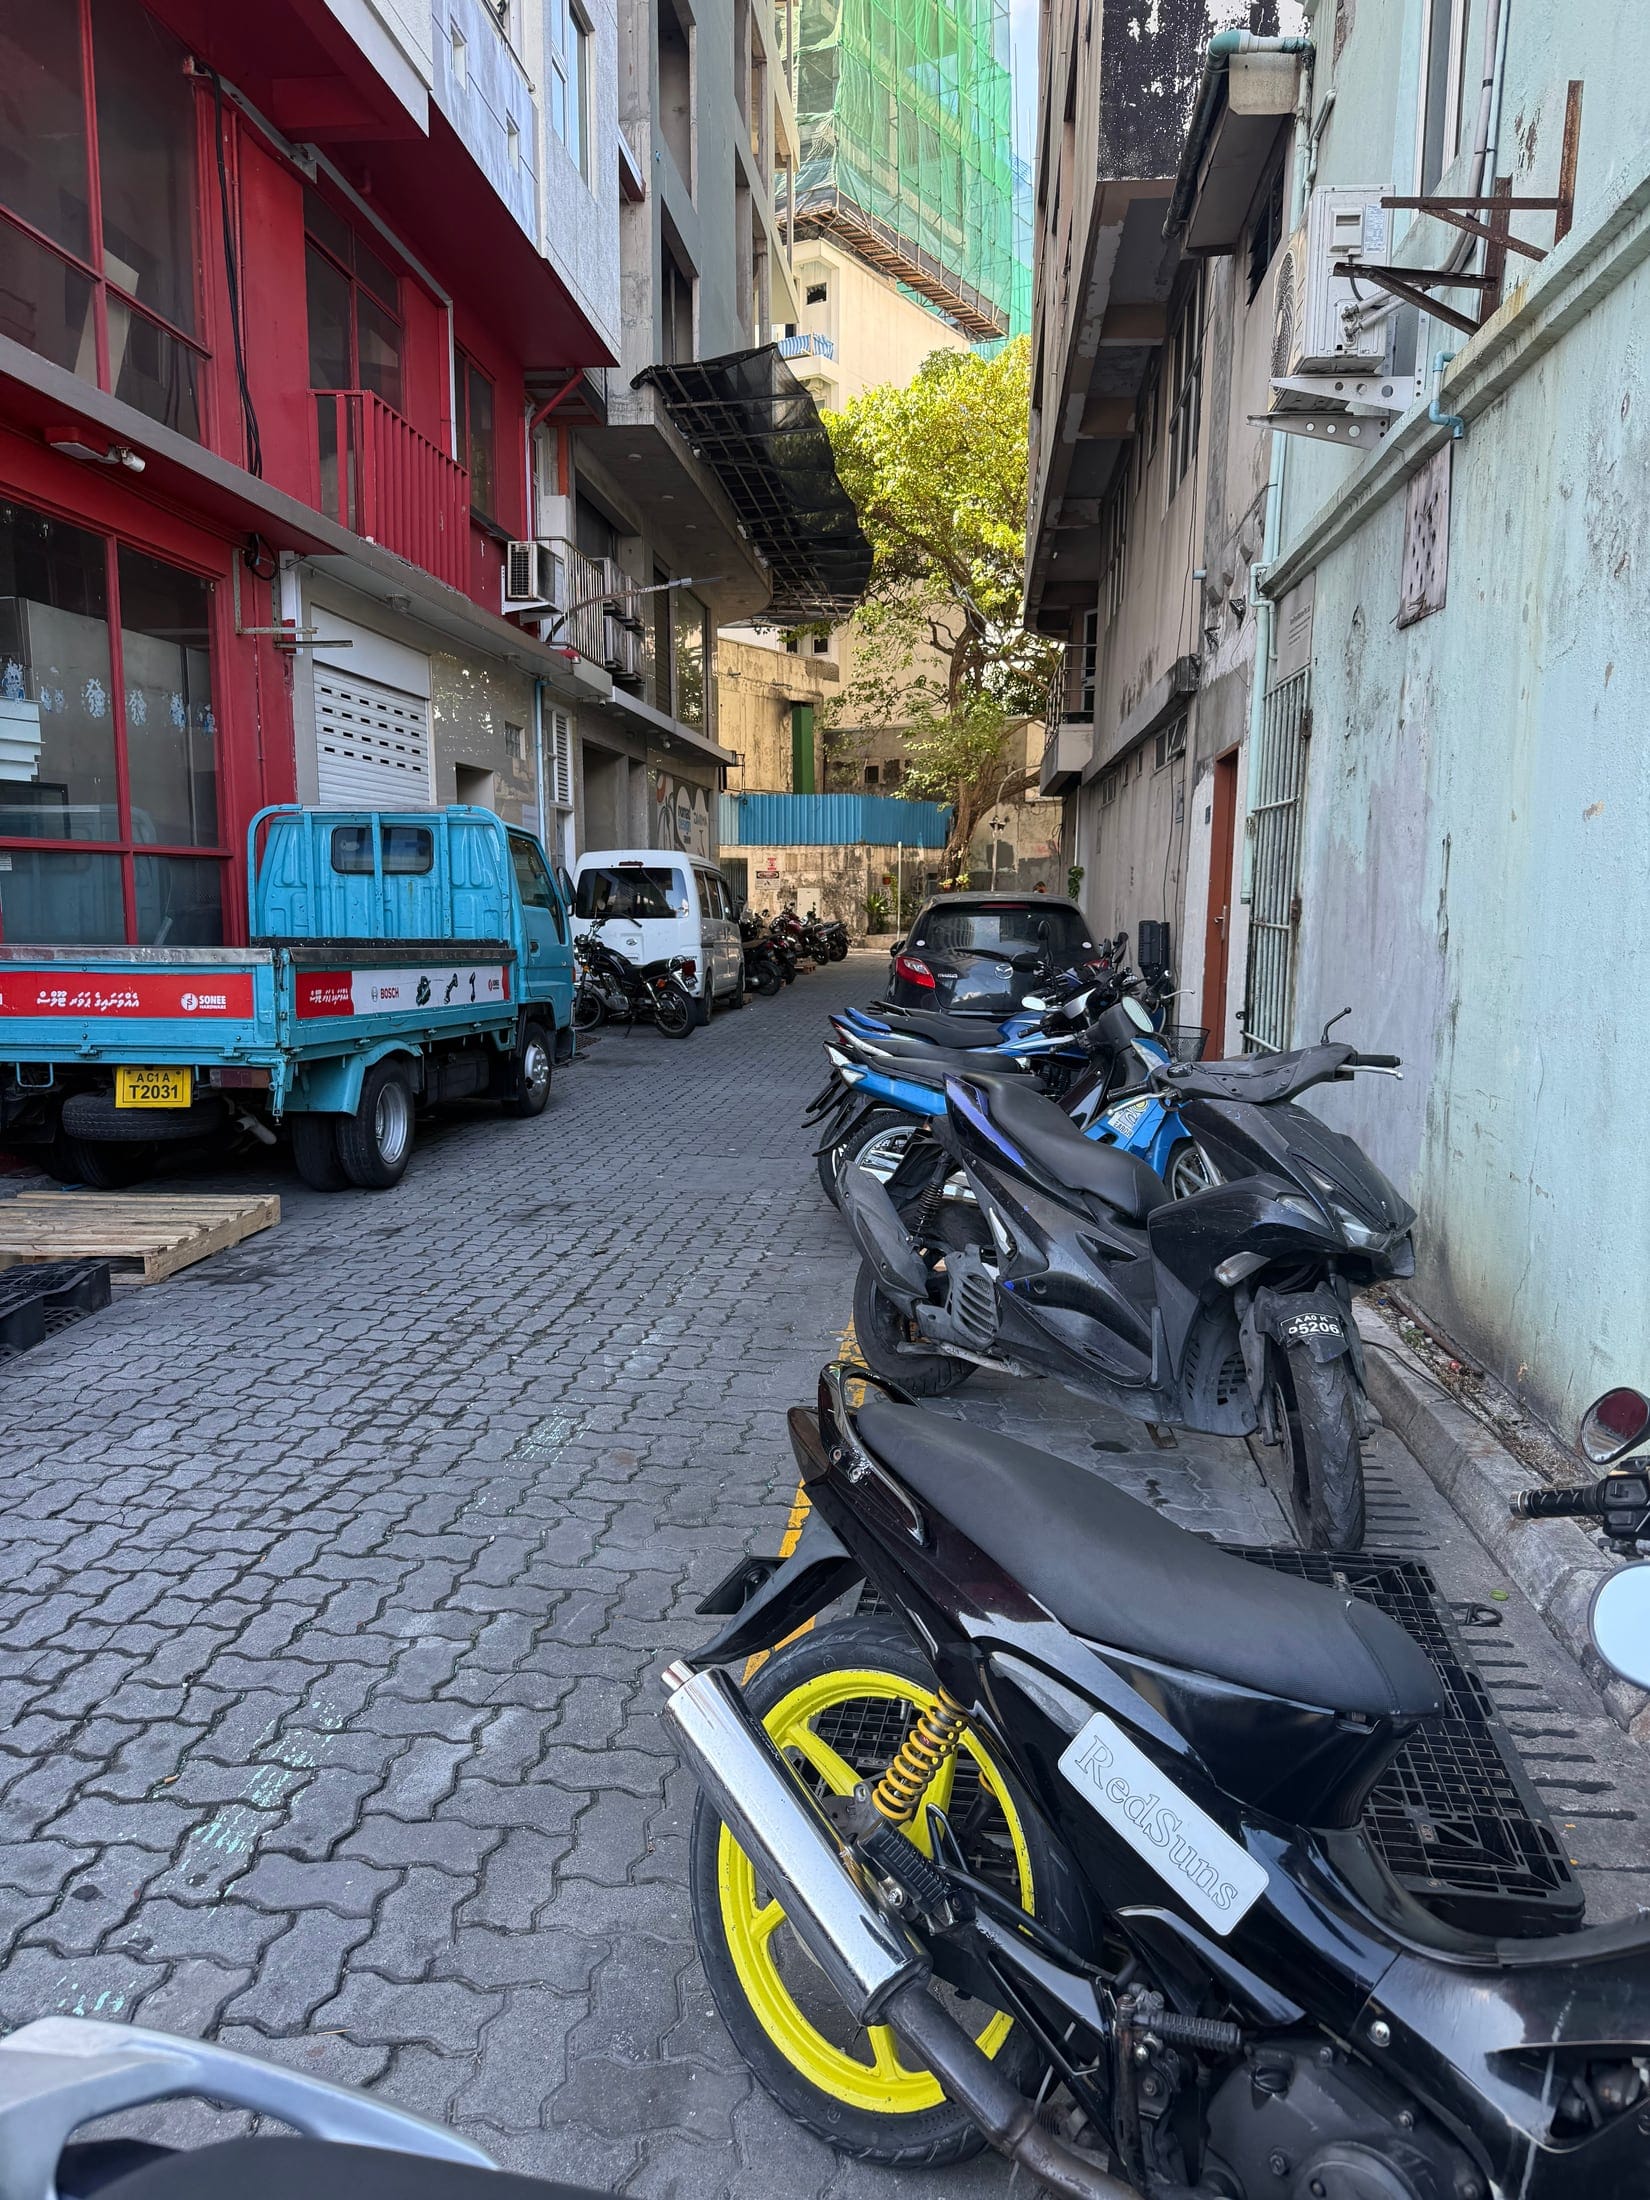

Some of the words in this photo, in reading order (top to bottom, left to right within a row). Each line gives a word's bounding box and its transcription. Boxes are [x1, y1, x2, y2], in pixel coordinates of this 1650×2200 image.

[198, 995, 227, 1005] SONEE
[380, 986, 400, 1000] BOSCH
[128, 1084, 178, 1100] T2031
[1074, 1734, 1239, 1911] RedSuns
